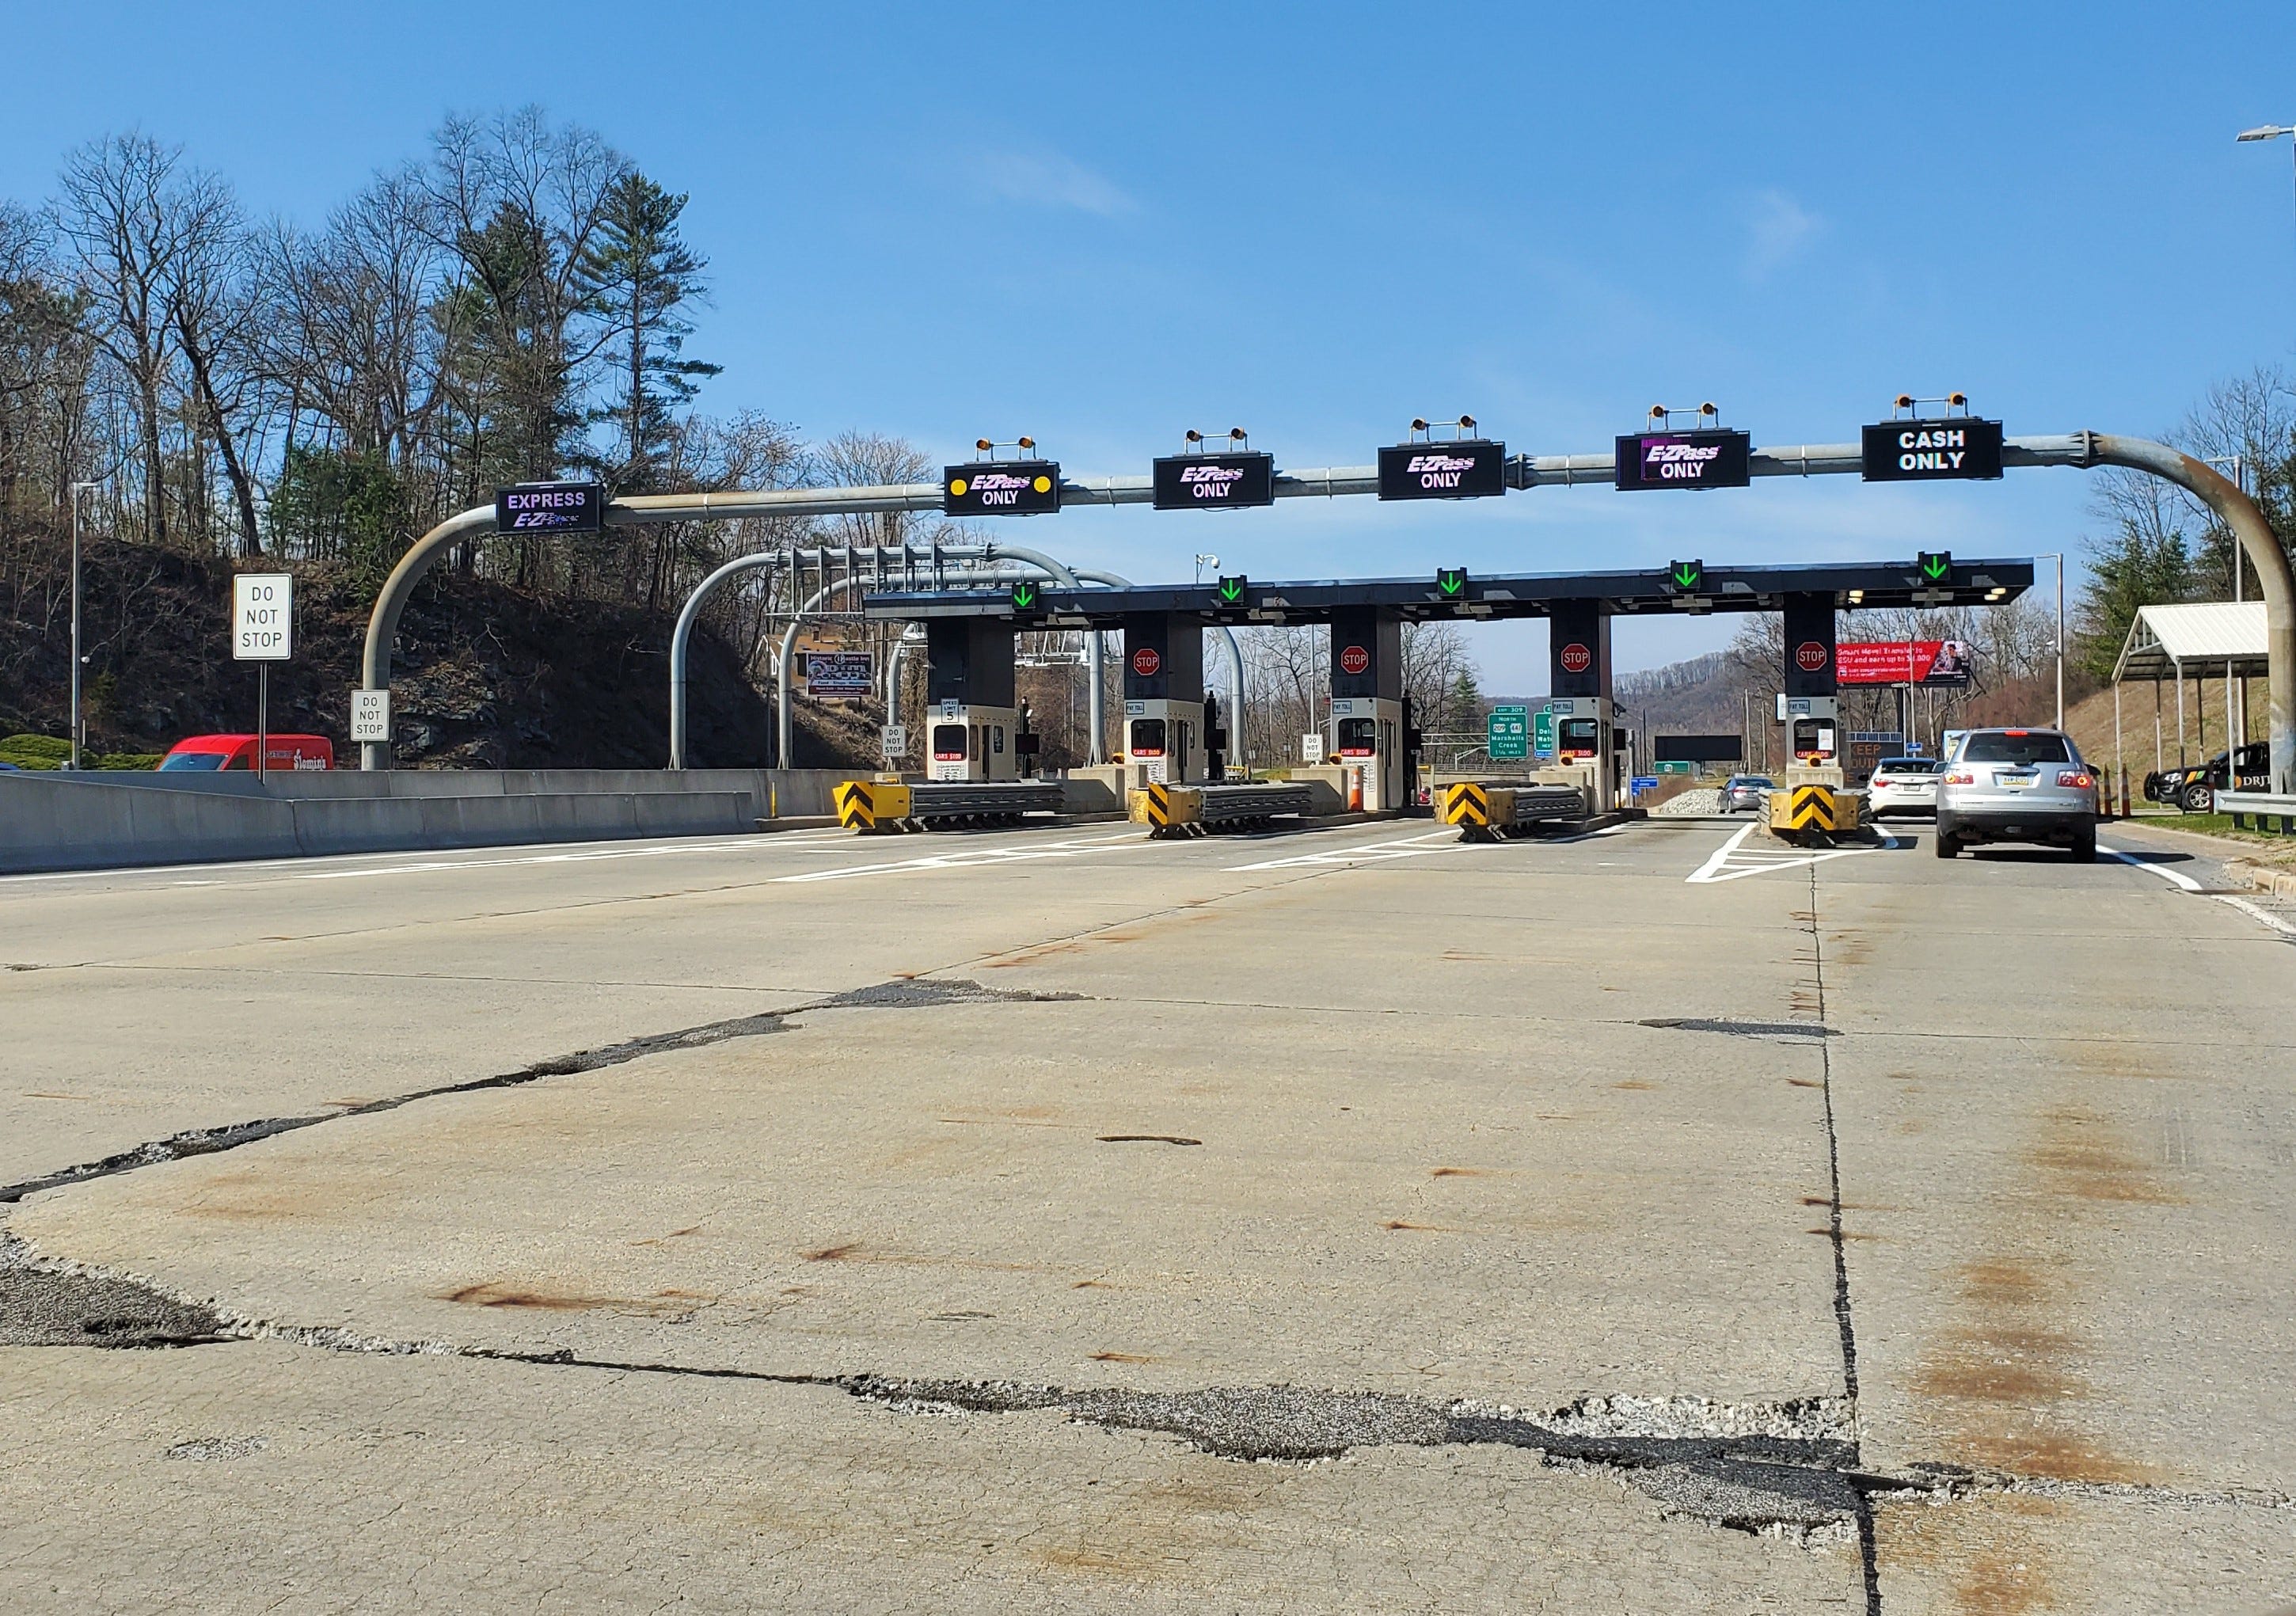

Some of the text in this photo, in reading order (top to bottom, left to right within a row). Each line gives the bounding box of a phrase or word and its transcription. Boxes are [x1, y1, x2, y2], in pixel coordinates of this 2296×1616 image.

[1899, 430, 1965, 449] CASH
[1899, 451, 1966, 470] ONLY
[1660, 462, 1705, 478] ONLY
[1420, 472, 1462, 489] ONLY
[982, 490, 1019, 504] ONLY
[1192, 482, 1231, 498] ONLY
[507, 492, 586, 509] EXPRESS
[252, 586, 273, 601] DO
[246, 609, 278, 624] NOT
[242, 632, 282, 647] STOP
[1136, 657, 1158, 667] STOP
[1344, 655, 1367, 665] STOP
[1564, 652, 1588, 663] STOP
[1800, 651, 1825, 662] STOP
[363, 697, 378, 706] DO
[359, 711, 381, 721] NOT
[947, 712, 954, 721] 5
[356, 724, 383, 734] STOP
